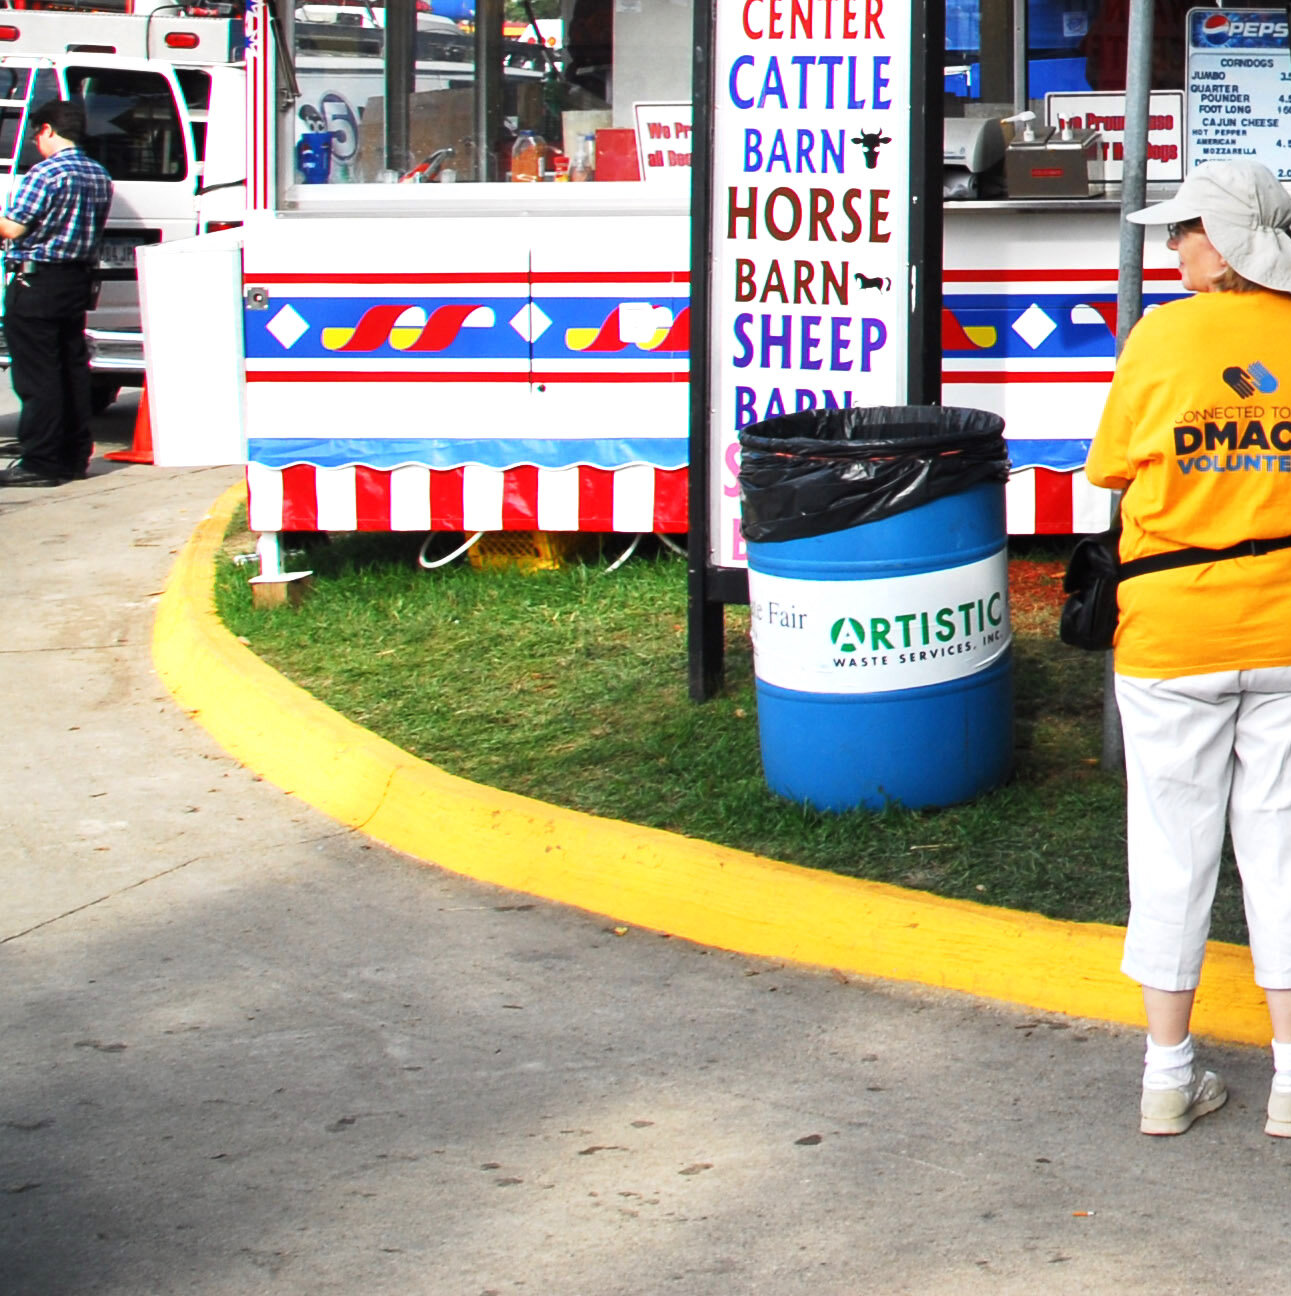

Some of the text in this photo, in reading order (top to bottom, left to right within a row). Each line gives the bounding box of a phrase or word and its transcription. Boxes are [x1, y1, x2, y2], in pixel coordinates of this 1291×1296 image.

[1228, 22, 1290, 38] PEPS
[1221, 58, 1274, 67] CORNDOGS
[728, 55, 892, 110] CATTLE
[1191, 72, 1225, 80] JUMBO
[1190, 85, 1239, 93] QUARTER
[1201, 94, 1250, 103] POUNDER
[1199, 105, 1223, 114] FOOT
[1225, 105, 1252, 114] LONG
[1202, 118, 1279, 127] CAJUN CHEESE
[744, 128, 845, 174] BARN
[727, 186, 892, 244] HORSE
[735, 258, 849, 306] BARN
[732, 313, 887, 373] SHEEP
[1272, 406, 1291, 419] TO
[769, 600, 807, 630] Fair
[831, 591, 1003, 653] ARTISTIC
[833, 656, 888, 668] WASTE
